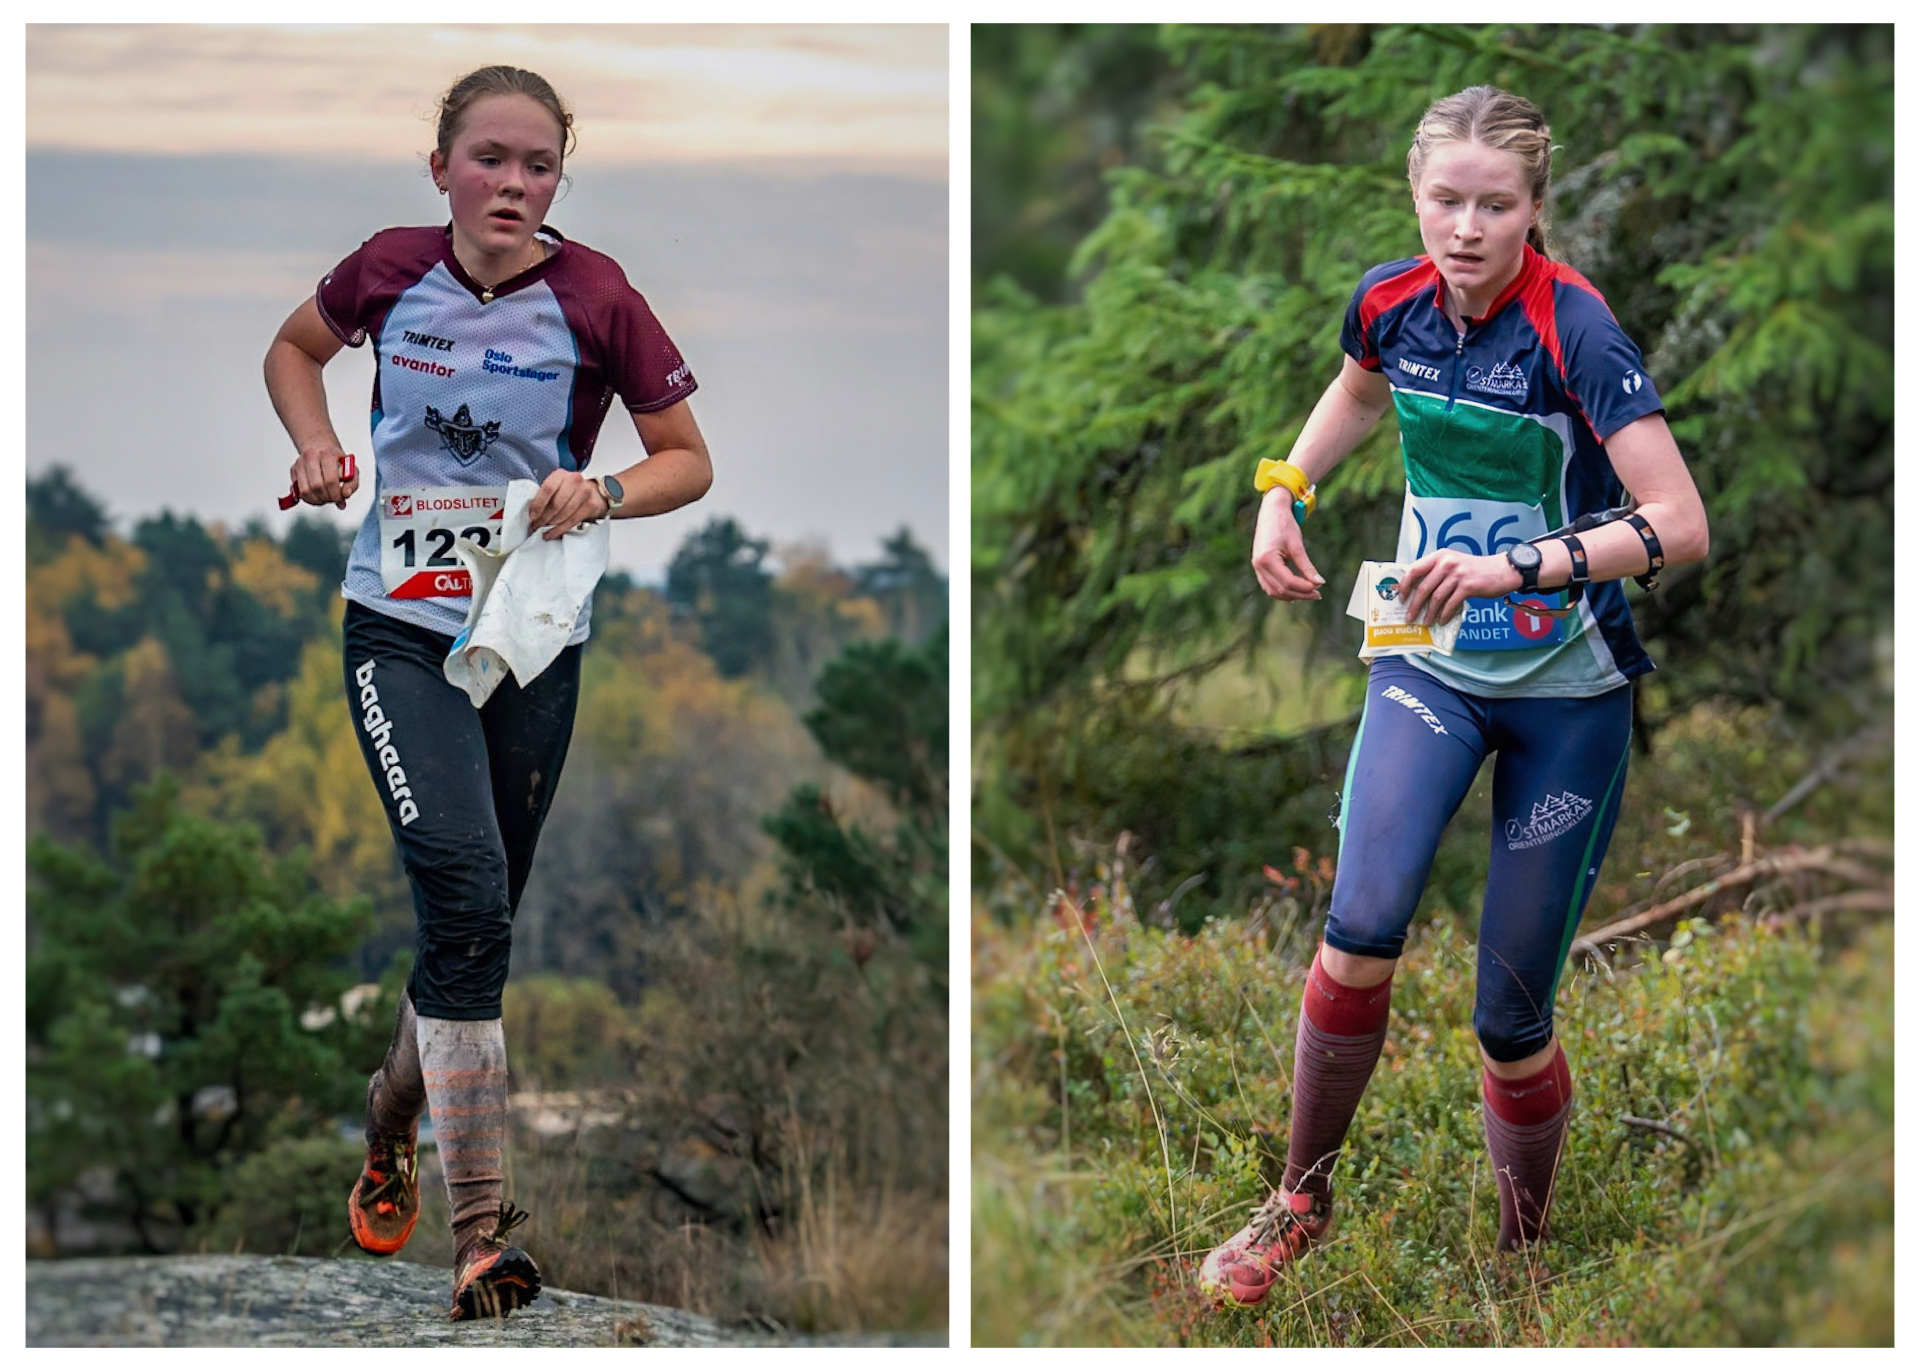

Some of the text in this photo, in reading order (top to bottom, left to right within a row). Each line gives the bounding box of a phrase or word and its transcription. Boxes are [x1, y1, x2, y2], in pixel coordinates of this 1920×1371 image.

[402, 330, 455, 352] TRIMTEX
[391, 354, 456, 378] avantor
[485, 348, 512, 363] Oslo
[482, 359, 560, 382] Sportslager
[1399, 357, 1441, 382] TRIMTEX
[416, 497, 499, 511] BLODSLITET
[393, 526, 502, 568] 122
[1373, 627, 1394, 637] nord
[1381, 685, 1449, 735] TRIMTEX
[355, 658, 420, 827] bagheera
